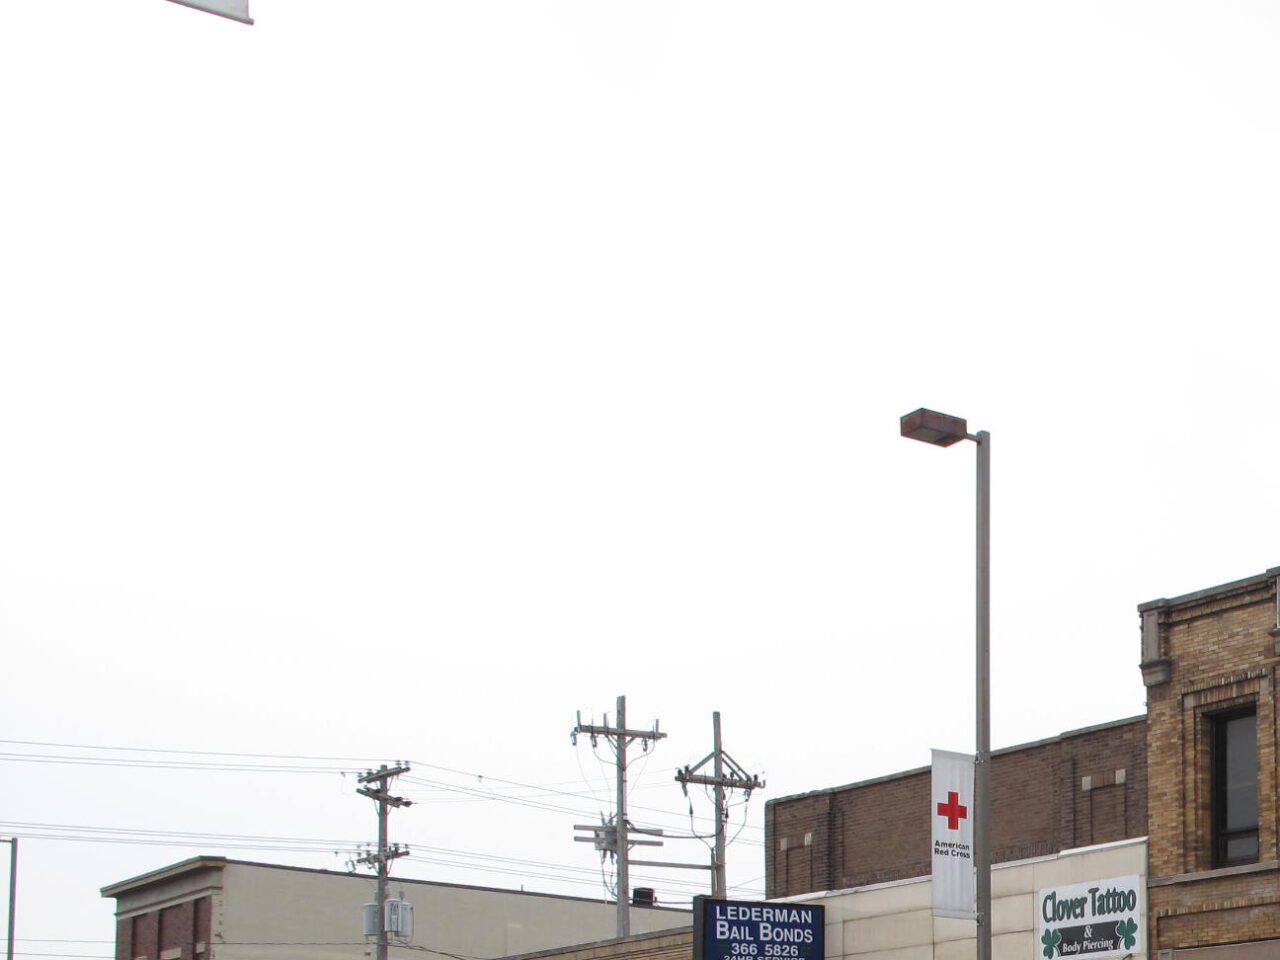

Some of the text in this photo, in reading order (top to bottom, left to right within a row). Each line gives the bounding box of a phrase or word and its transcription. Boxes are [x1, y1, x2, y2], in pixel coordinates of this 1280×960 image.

[934, 847, 970, 859] Red Cross
[935, 840, 970, 851] American
[1042, 887, 1137, 923] Clover Tattoo
[716, 905, 812, 924] LEDERMAN
[716, 921, 813, 944] BAIL BONDS
[1084, 925, 1093, 938] &
[731, 943, 799, 957] 366 5826
[1062, 938, 1114, 955] Body Piercing
